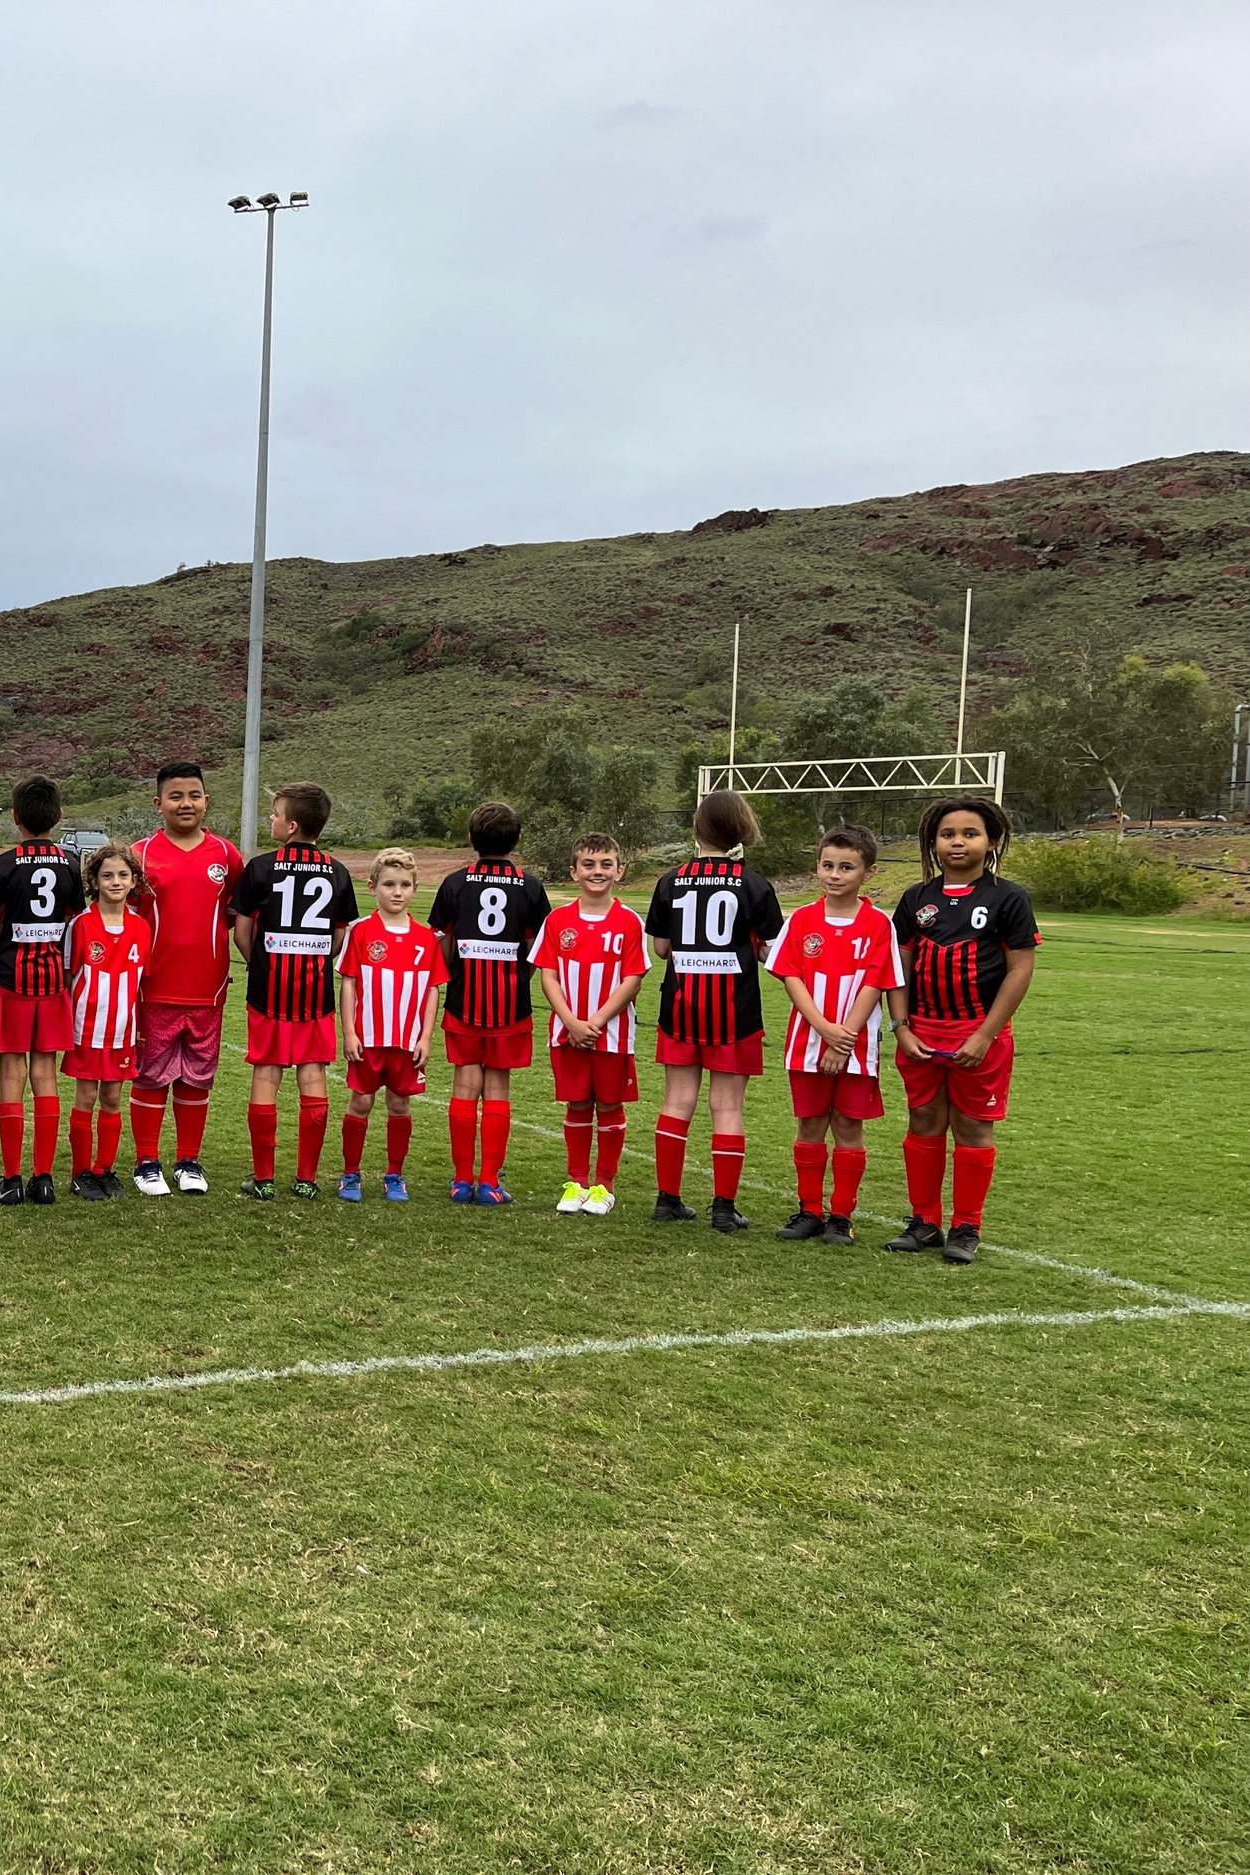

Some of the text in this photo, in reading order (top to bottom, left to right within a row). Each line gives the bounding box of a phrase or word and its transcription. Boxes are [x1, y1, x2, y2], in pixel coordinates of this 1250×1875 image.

[15, 856, 32, 865] SALT
[33, 856, 59, 864] JUNIOR
[273, 862, 334, 874] SALT JUNIOR S.C
[466, 874, 525, 887] SALT JUNIOR S.C
[674, 876, 742, 887] SALT JUNIOR S.C
[30, 867, 57, 918] 3
[272, 875, 333, 930] 12
[477, 886, 508, 936] 8
[671, 890, 739, 947] 10
[970, 906, 989, 930] 6
[127, 943, 140, 964] 4
[279, 940, 331, 949] LEICHHARDT
[600, 931, 625, 955] 10
[413, 944, 426, 966] 7
[681, 958, 738, 967] LEICHHARDT
